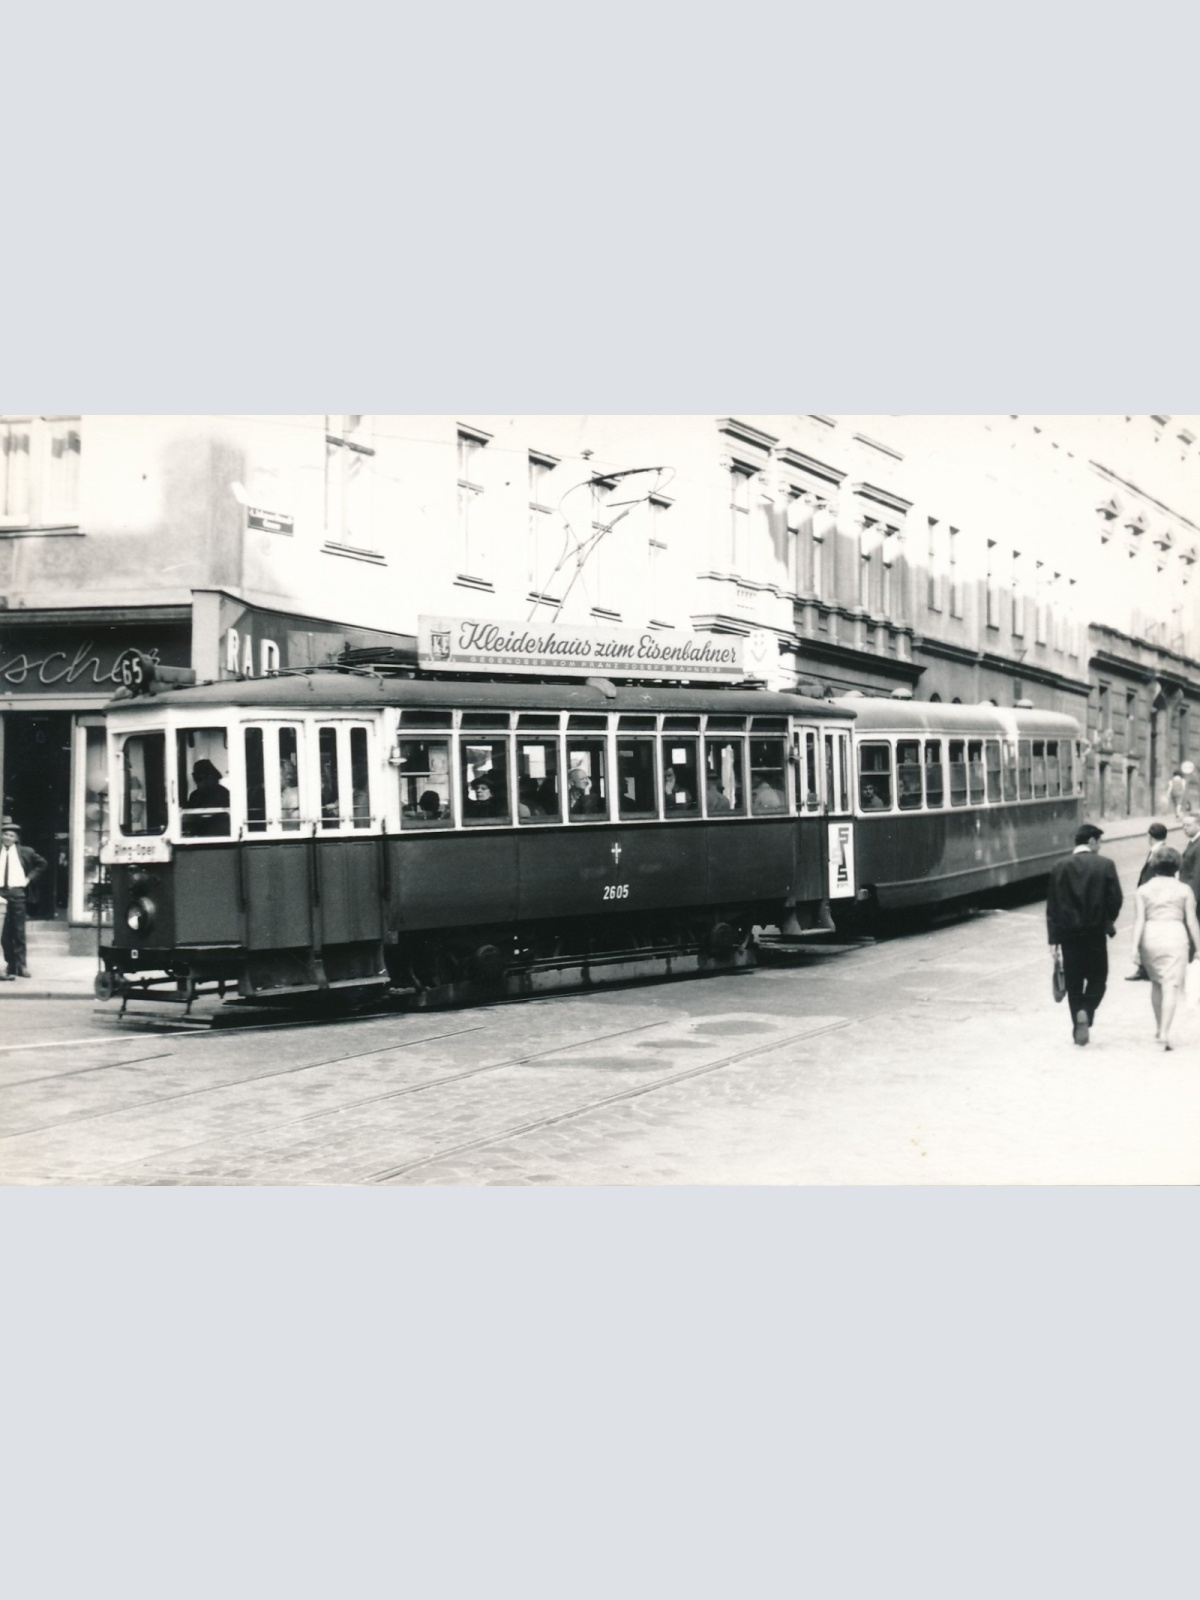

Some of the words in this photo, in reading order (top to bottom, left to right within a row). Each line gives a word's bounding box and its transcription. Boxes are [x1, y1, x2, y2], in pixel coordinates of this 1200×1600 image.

[227, 628, 280, 678] RAD
[459, 621, 592, 655] Kleiderhaus
[637, 635, 737, 663] Eisenbahner
[122, 657, 143, 685] 65
[552, 660, 576, 668] VOM
[581, 661, 619, 670] FRANZ
[672, 665, 722, 673] BAHNHOF
[603, 884, 629, 900] 2605
